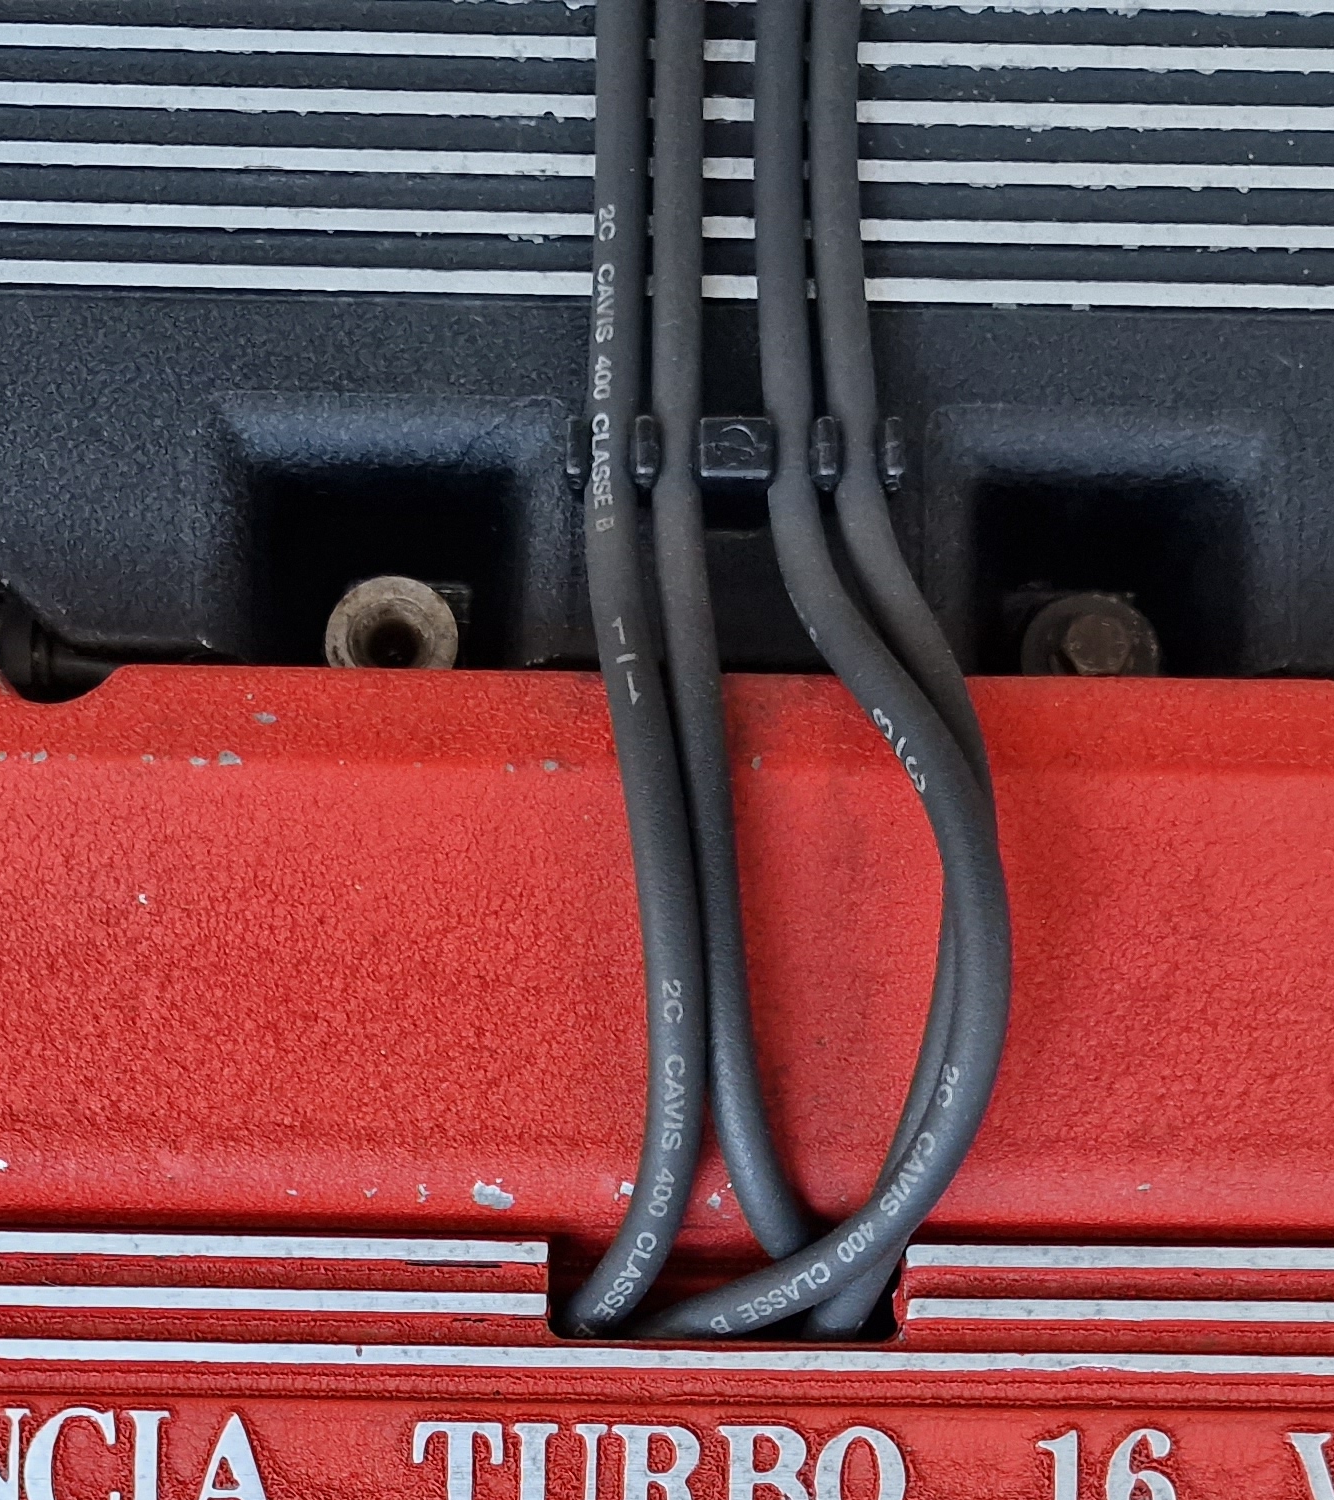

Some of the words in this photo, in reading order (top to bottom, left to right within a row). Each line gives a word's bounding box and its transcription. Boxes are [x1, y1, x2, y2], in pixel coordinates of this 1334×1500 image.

[598, 204, 616, 242] 2C
[595, 263, 616, 344] CAVIS
[593, 355, 612, 400] 400
[591, 413, 614, 510] CLASSE
[662, 979, 684, 1025] 2C
[661, 1054, 686, 1151] CAVIS
[648, 1167, 675, 1218] 400
[880, 1131, 936, 1217] CAVIS
[836, 1221, 876, 1264] 400
[592, 1231, 657, 1322] CLASSE
[736, 1261, 832, 1324] CLASSE
[710, 1314, 733, 1334] B
